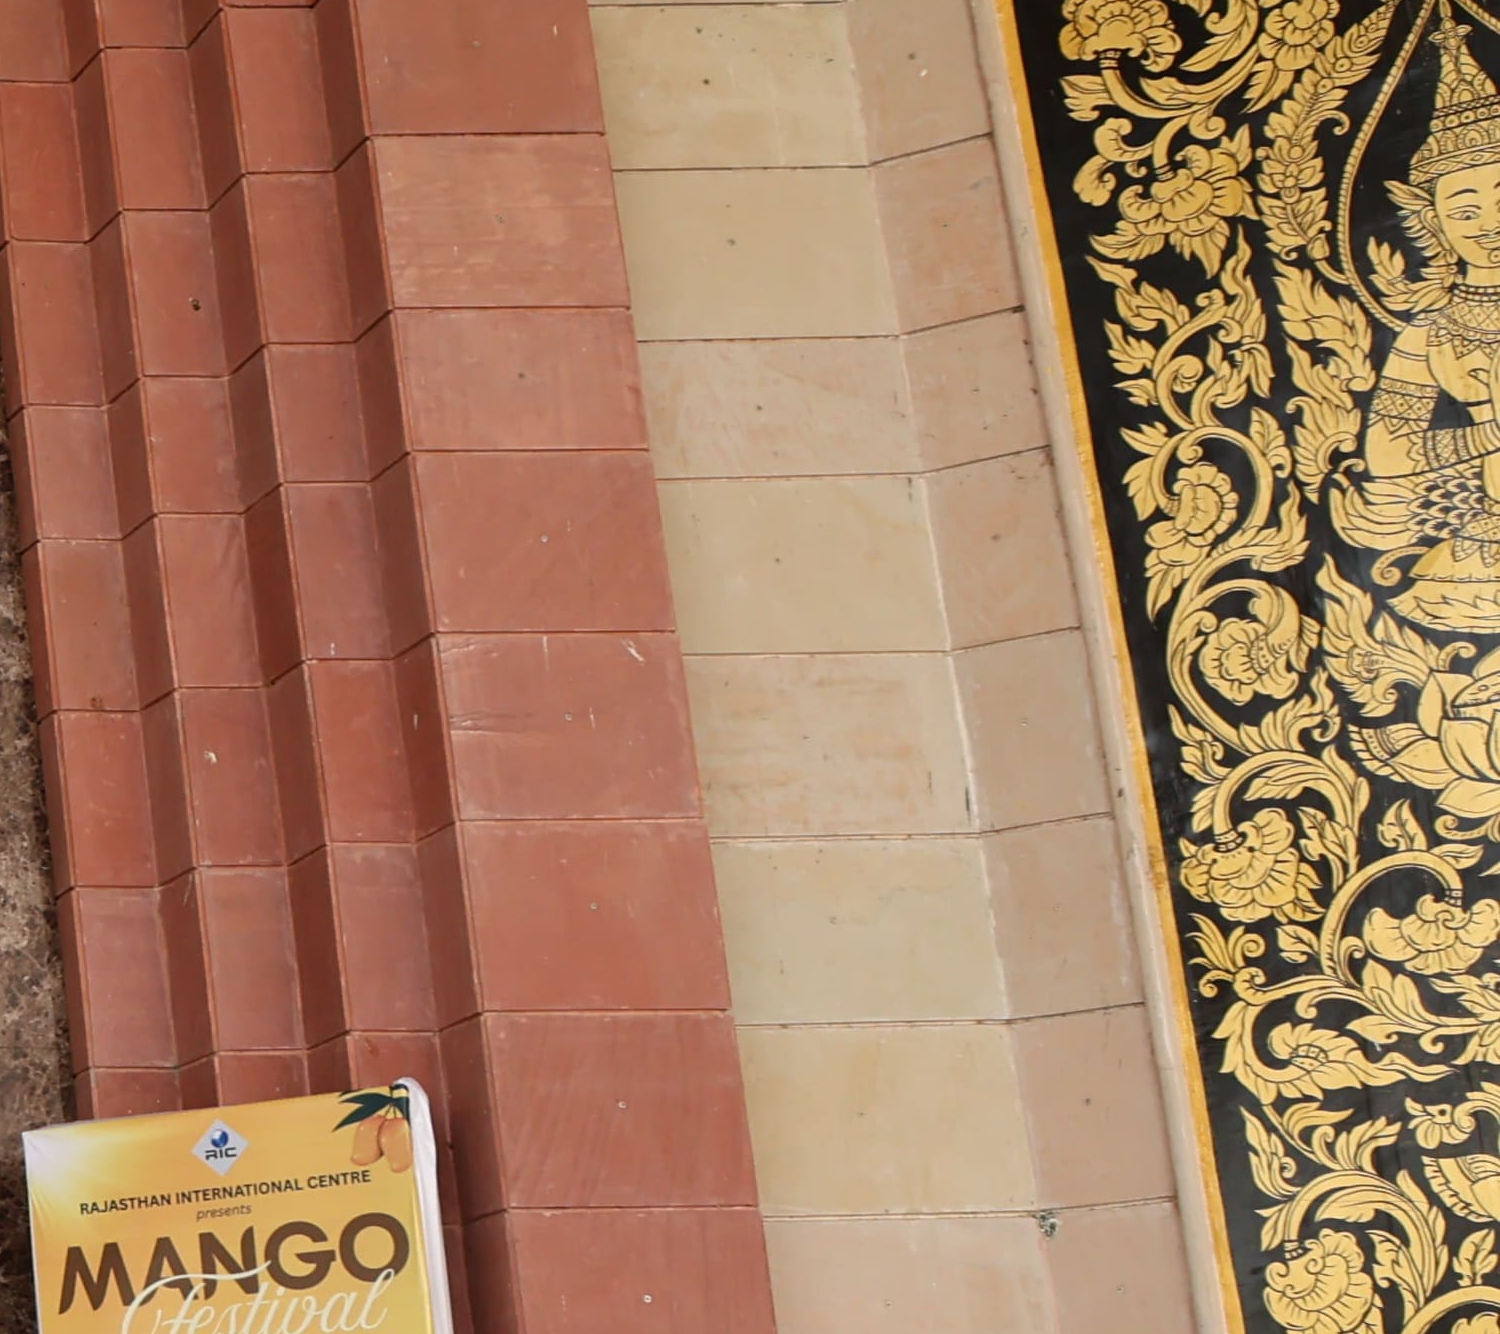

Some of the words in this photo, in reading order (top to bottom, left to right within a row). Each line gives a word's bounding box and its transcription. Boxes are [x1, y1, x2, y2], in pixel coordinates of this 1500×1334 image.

[205, 1147, 237, 1160] RIC
[80, 1192, 172, 1215] RAJASTHAN
[175, 1179, 303, 1205] INTERNATIONAL
[307, 1170, 371, 1188] CENTRE
[196, 1204, 252, 1222] presents
[58, 1212, 410, 1315] MANGO
